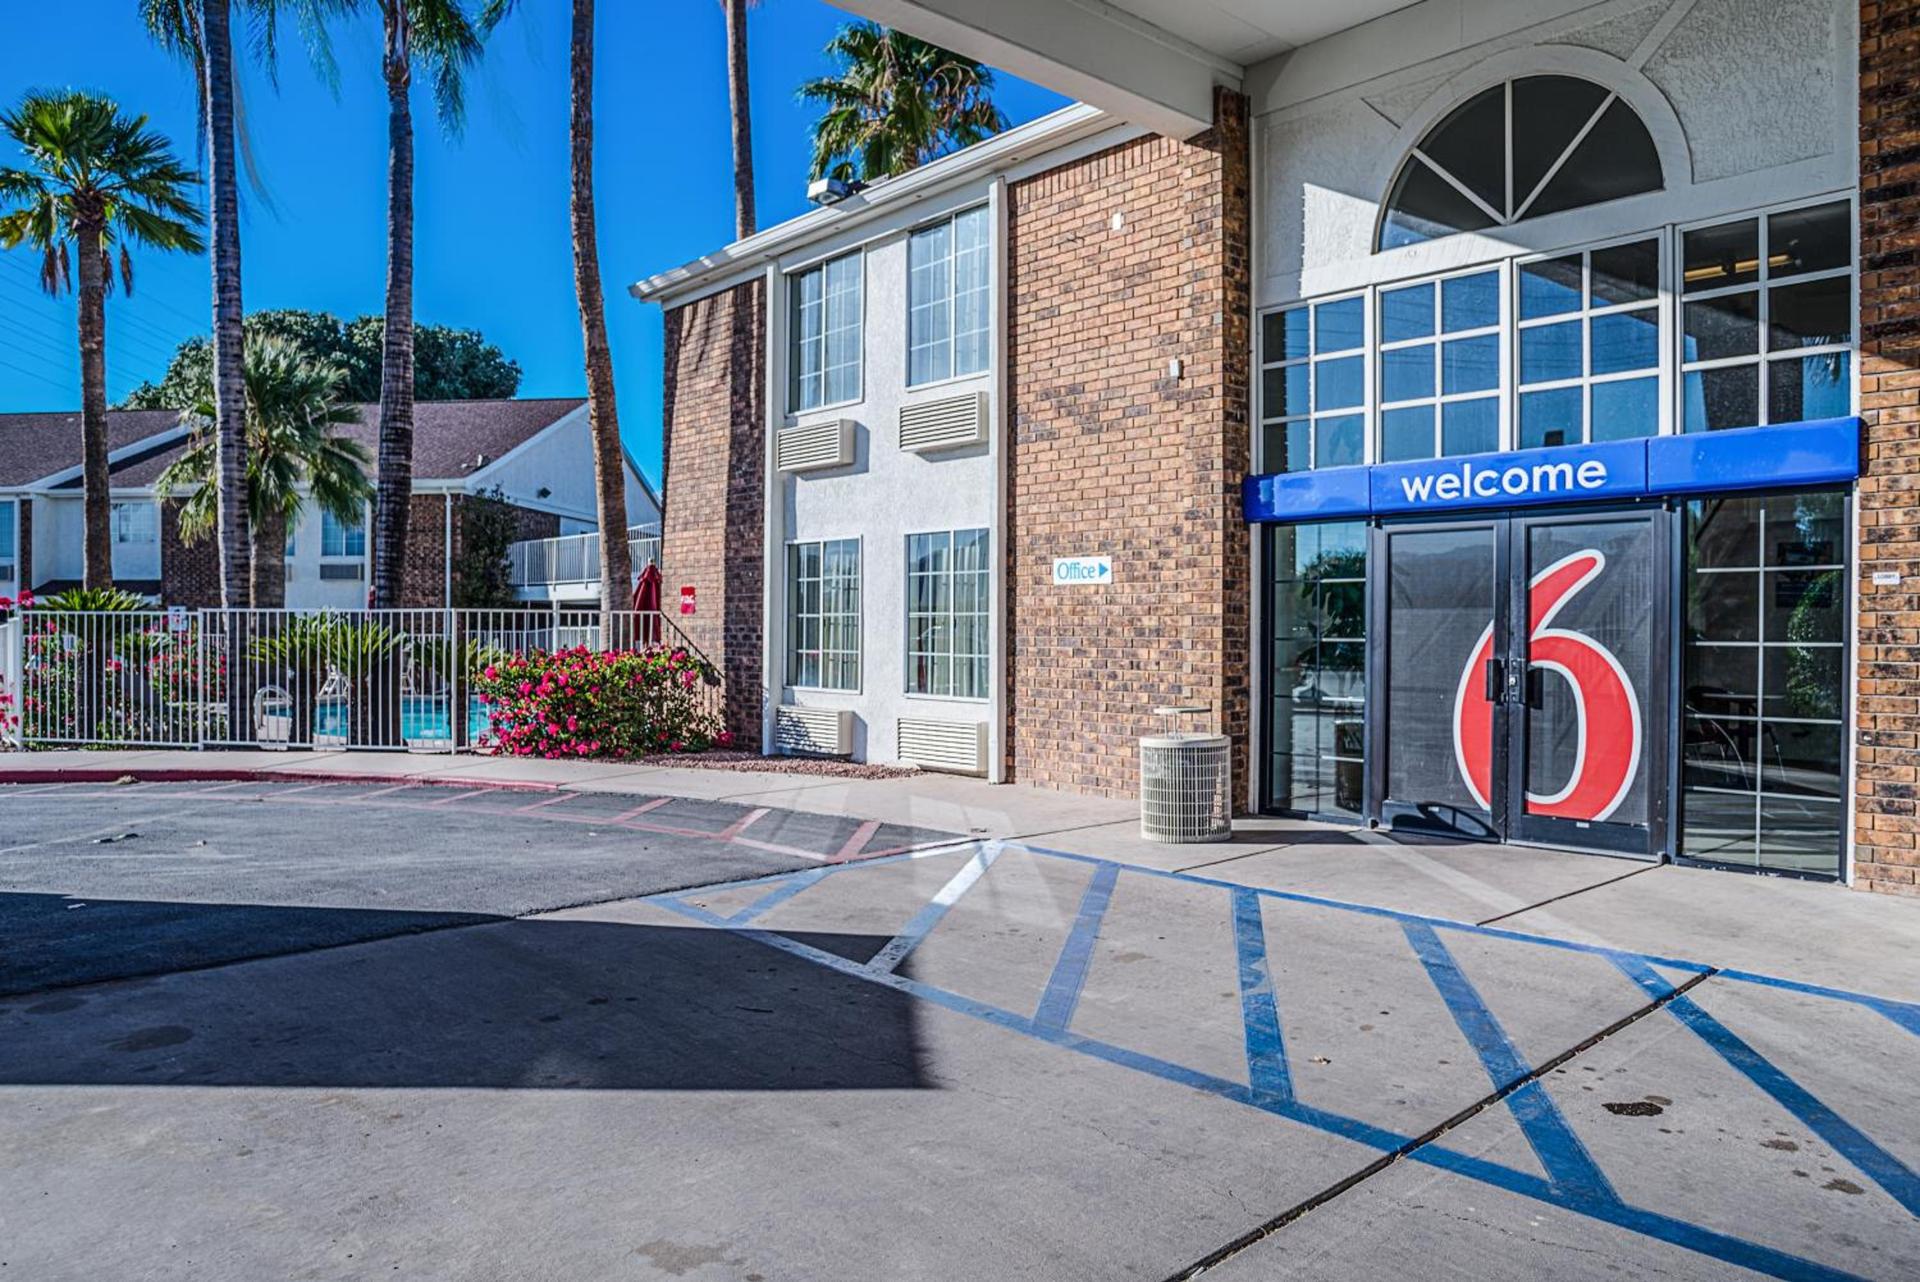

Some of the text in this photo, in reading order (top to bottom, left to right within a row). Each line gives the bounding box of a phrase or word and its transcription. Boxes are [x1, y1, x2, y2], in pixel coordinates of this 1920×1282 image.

[1401, 460, 1608, 502] welcome
[1057, 561, 1096, 580] Office
[1453, 548, 1642, 822] 6
